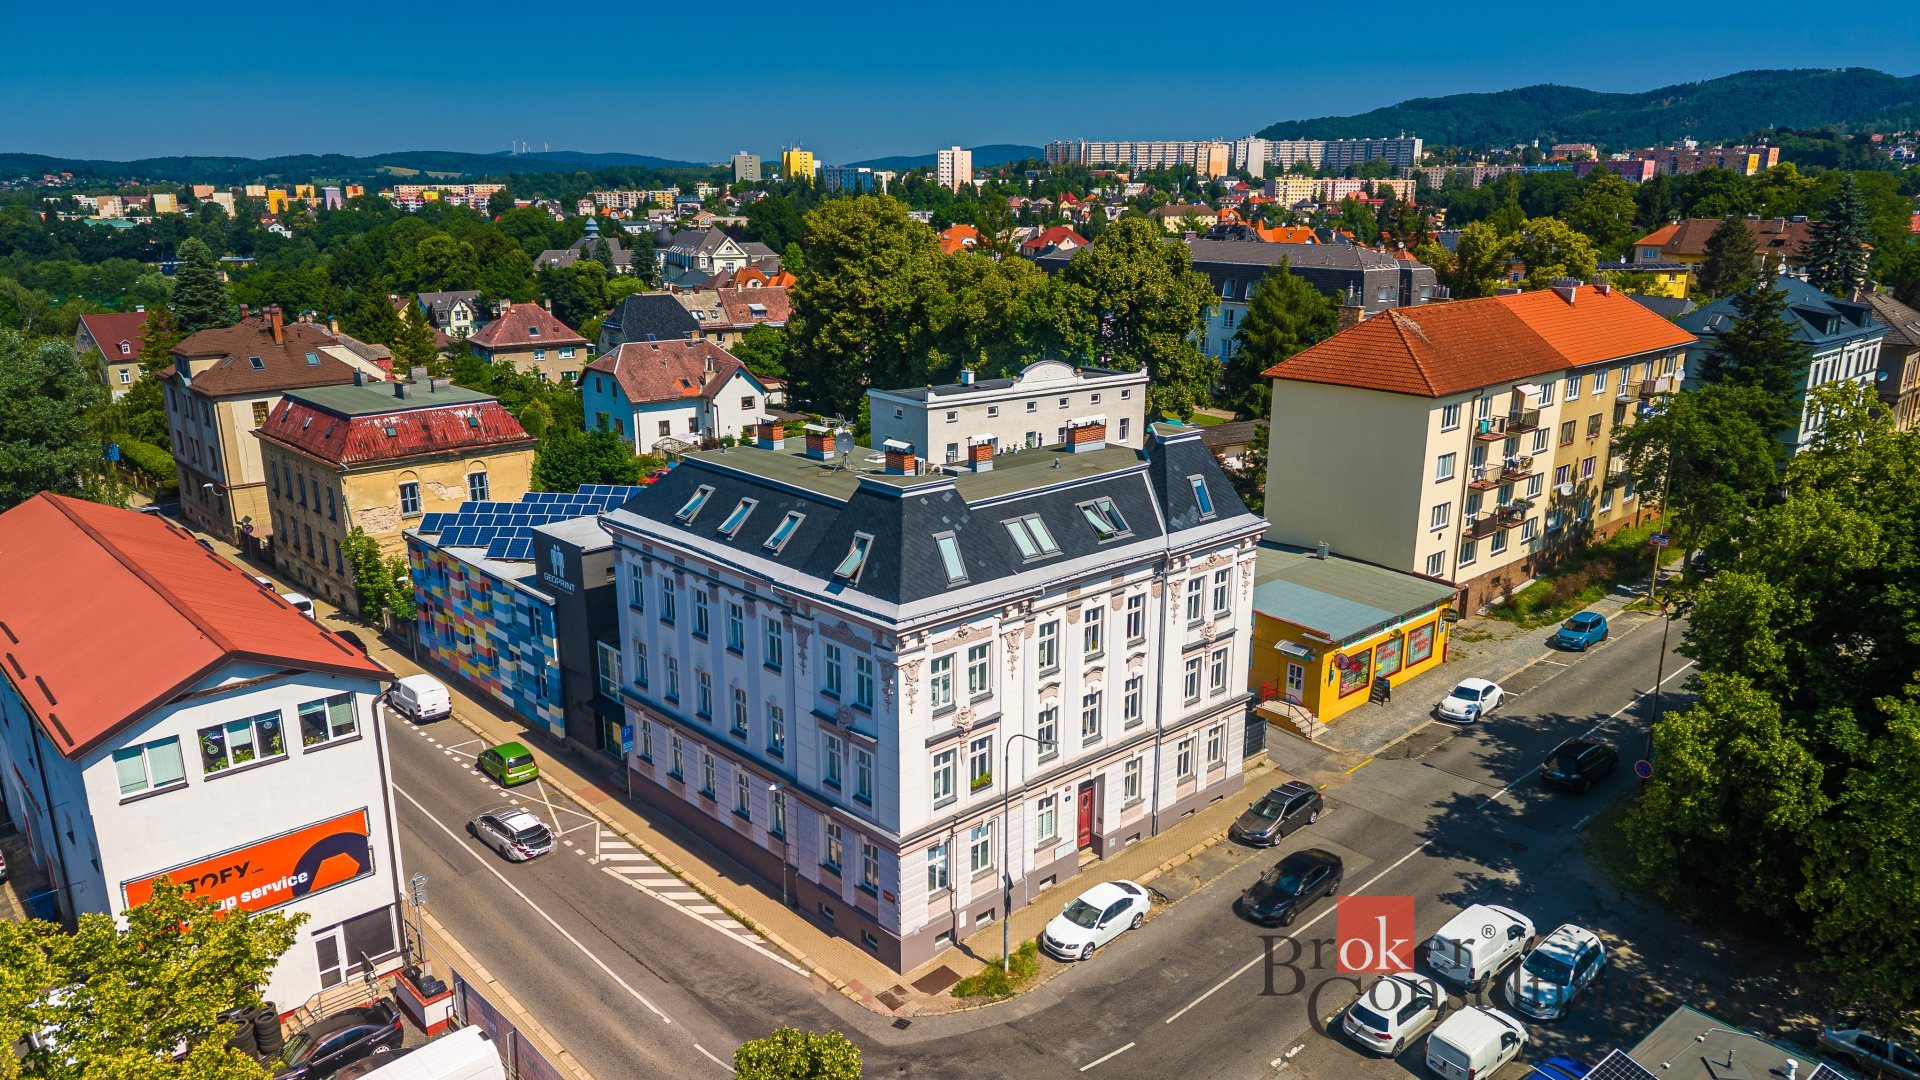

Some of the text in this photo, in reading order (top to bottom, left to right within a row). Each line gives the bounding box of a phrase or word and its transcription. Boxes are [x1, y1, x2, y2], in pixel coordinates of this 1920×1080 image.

[543, 572, 575, 591] GEOPRINT
[624, 728, 631, 738] P
[240, 871, 308, 903] service
